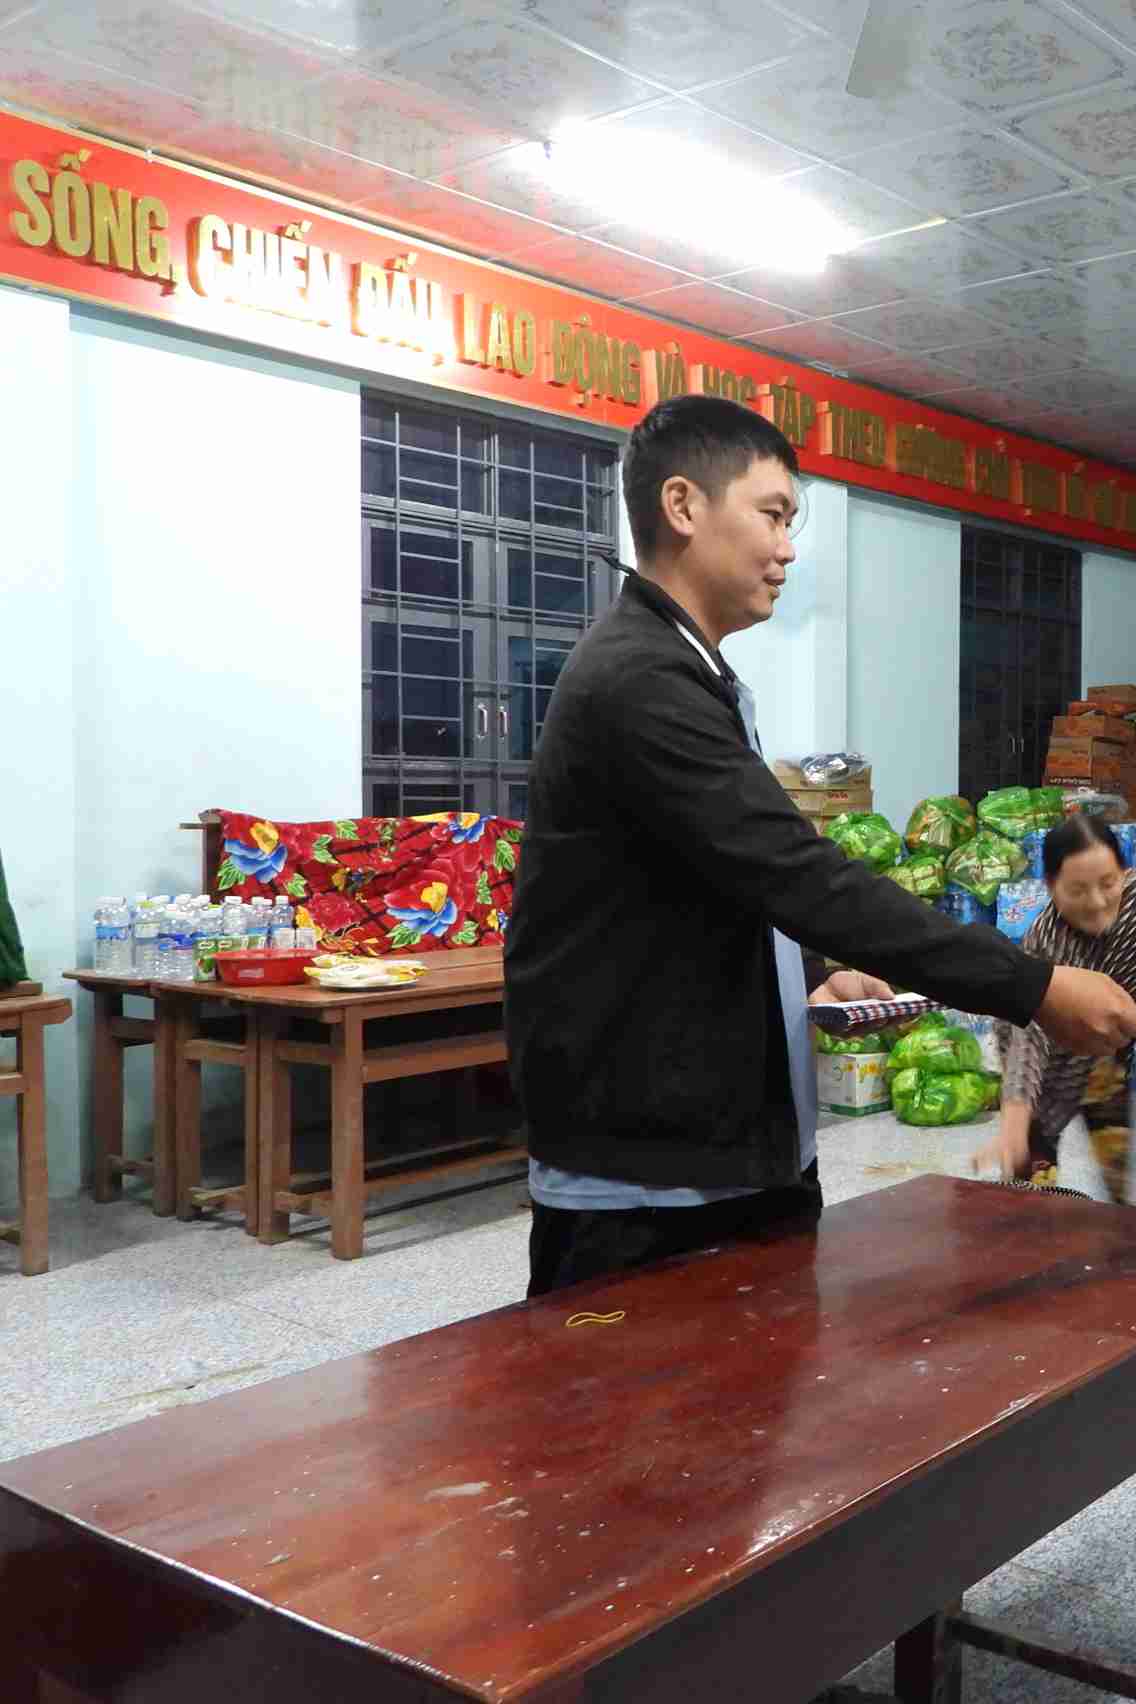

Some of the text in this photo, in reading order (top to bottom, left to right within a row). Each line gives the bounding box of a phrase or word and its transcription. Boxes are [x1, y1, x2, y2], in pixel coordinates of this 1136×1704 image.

[13, 148, 181, 287] SỐNG,
[190, 213, 343, 324] CHIẾN
[461, 292, 535, 376] LAO
[549, 313, 641, 405] ĐỘNG
